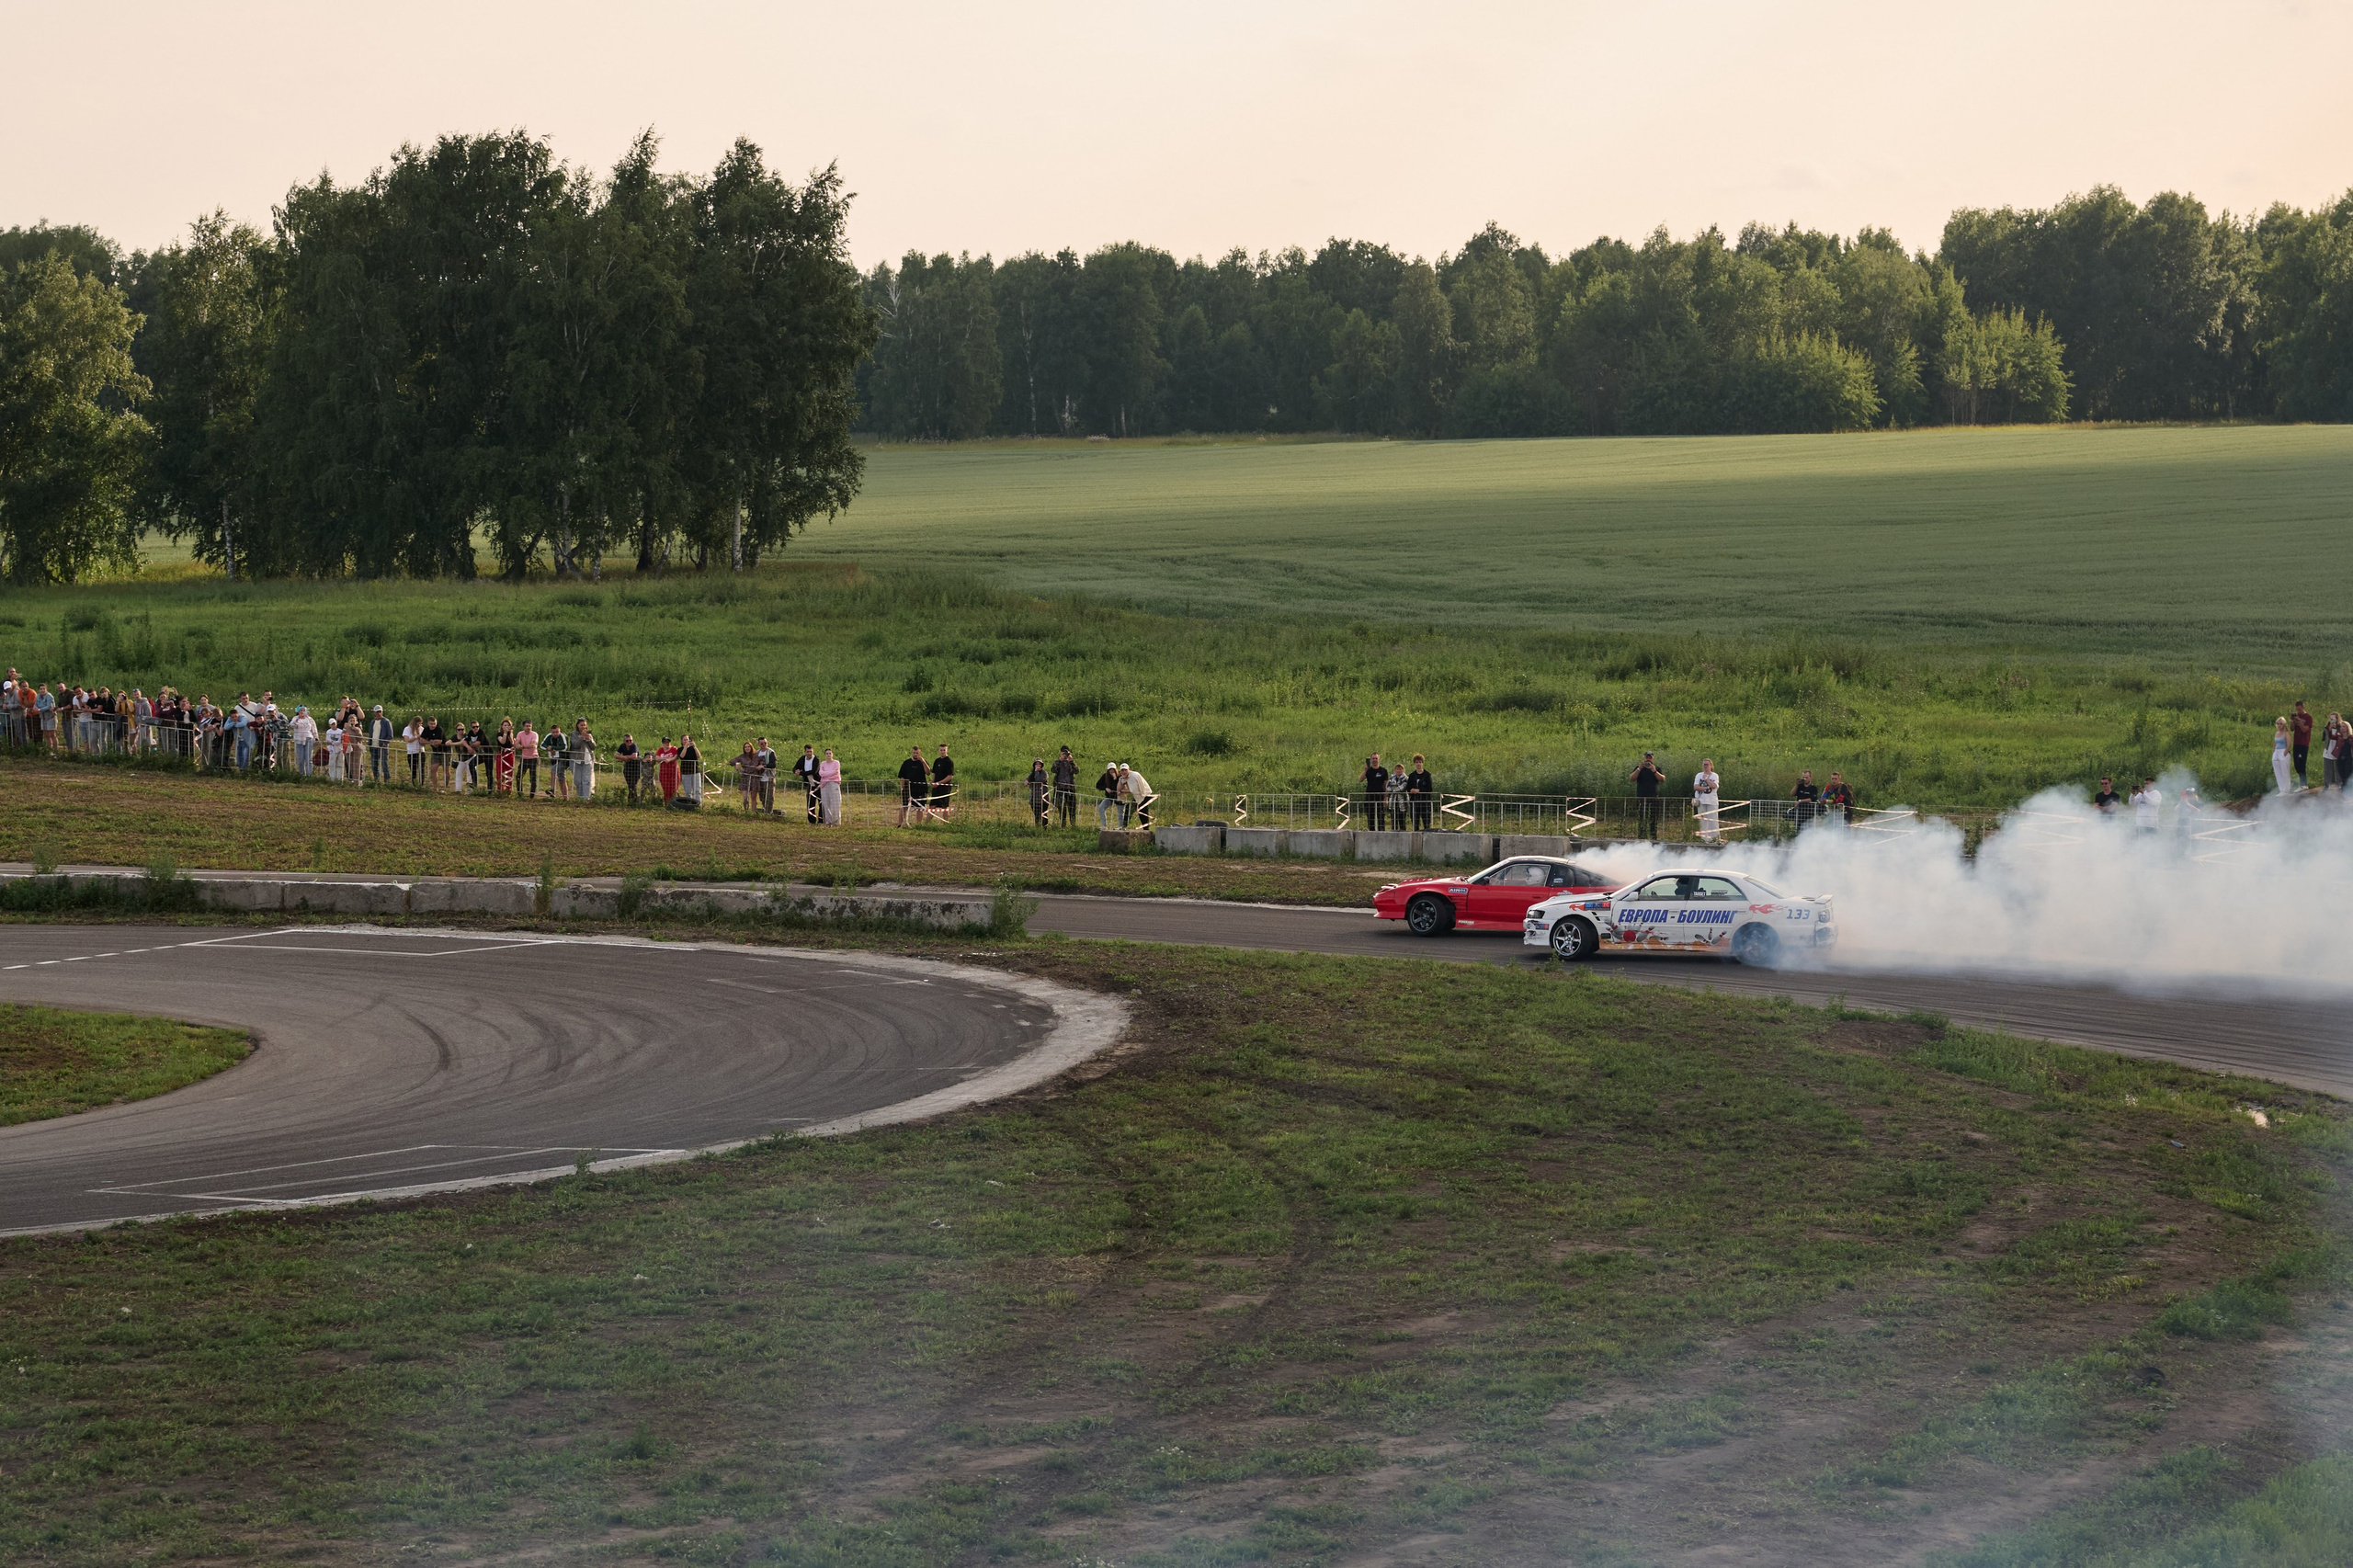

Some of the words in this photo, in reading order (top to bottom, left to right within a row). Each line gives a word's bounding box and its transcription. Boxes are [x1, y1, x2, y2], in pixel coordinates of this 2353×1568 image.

[1618, 909, 1669, 924] ЕВРОПА
[1677, 909, 1739, 925] БОУЛИНГ
[1786, 909, 1811, 920] 133
